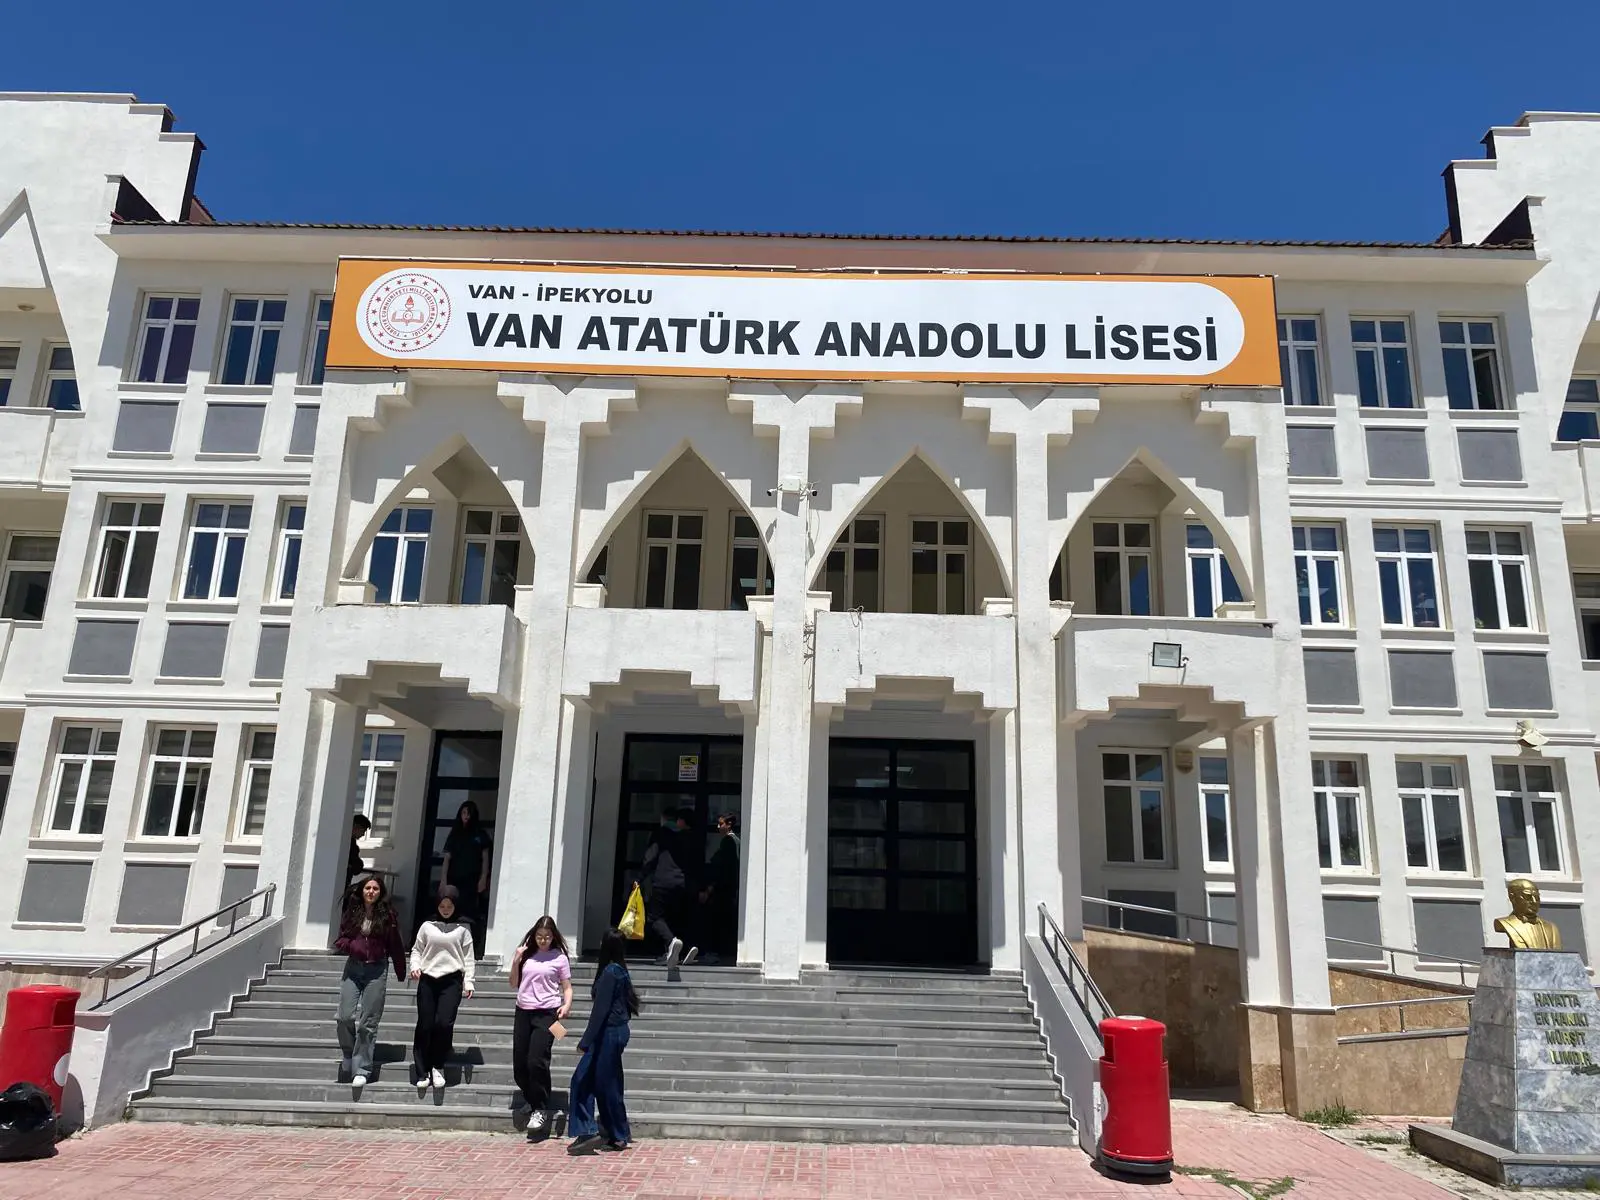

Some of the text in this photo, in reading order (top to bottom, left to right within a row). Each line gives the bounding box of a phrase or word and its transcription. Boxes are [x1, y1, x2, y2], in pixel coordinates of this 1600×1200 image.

[468, 284, 515, 300] VAN
[536, 283, 653, 305] İPEKYOLU
[466, 311, 1218, 361] VAN ATATÜRK ANADOLU LİSESİ
[1533, 992, 1581, 1008] HAYATTA
